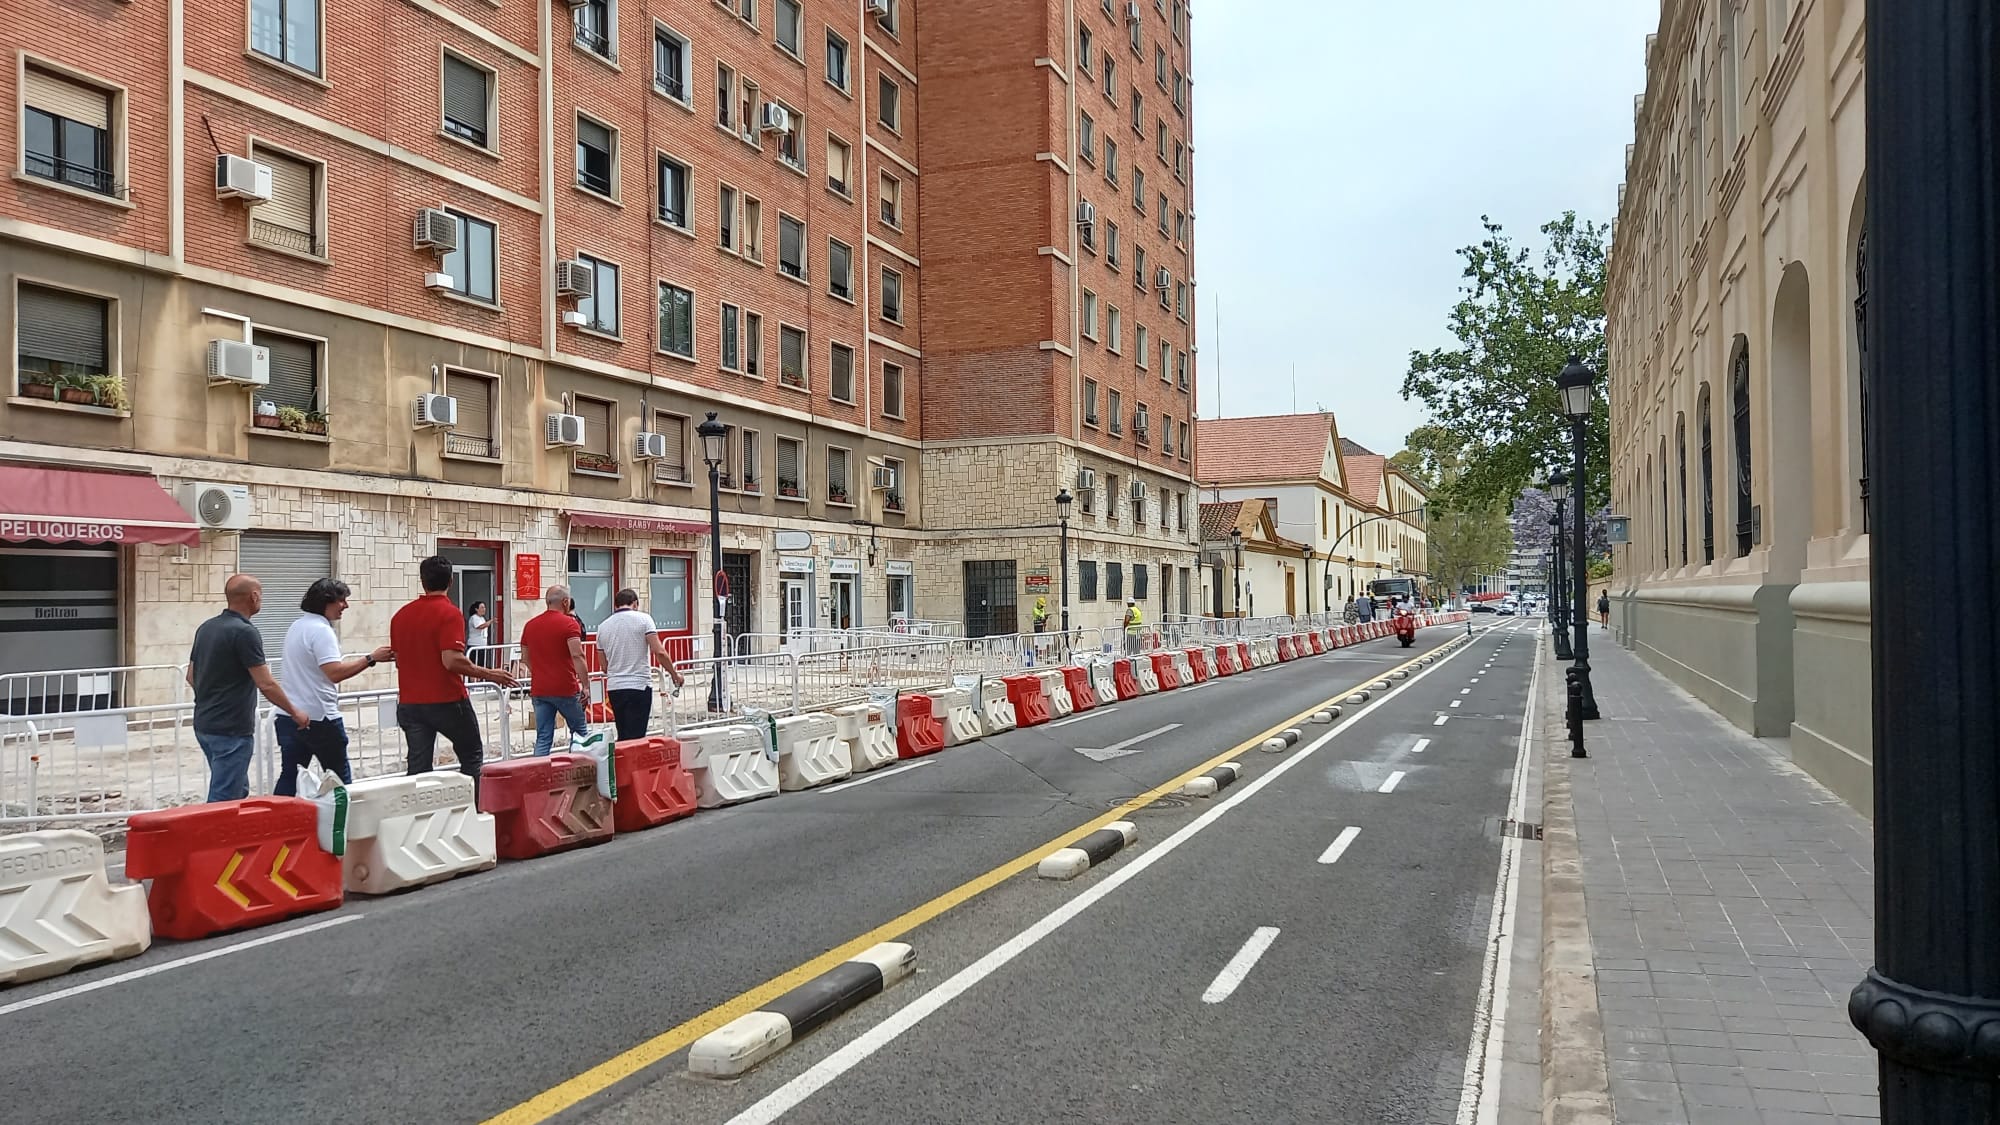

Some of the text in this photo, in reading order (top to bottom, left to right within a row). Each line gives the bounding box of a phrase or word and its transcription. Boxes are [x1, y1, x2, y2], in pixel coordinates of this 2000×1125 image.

[1, 520, 124, 539] PELUQUEROS
[1612, 523, 1621, 532] P
[35, 607, 78, 619] Beltran
